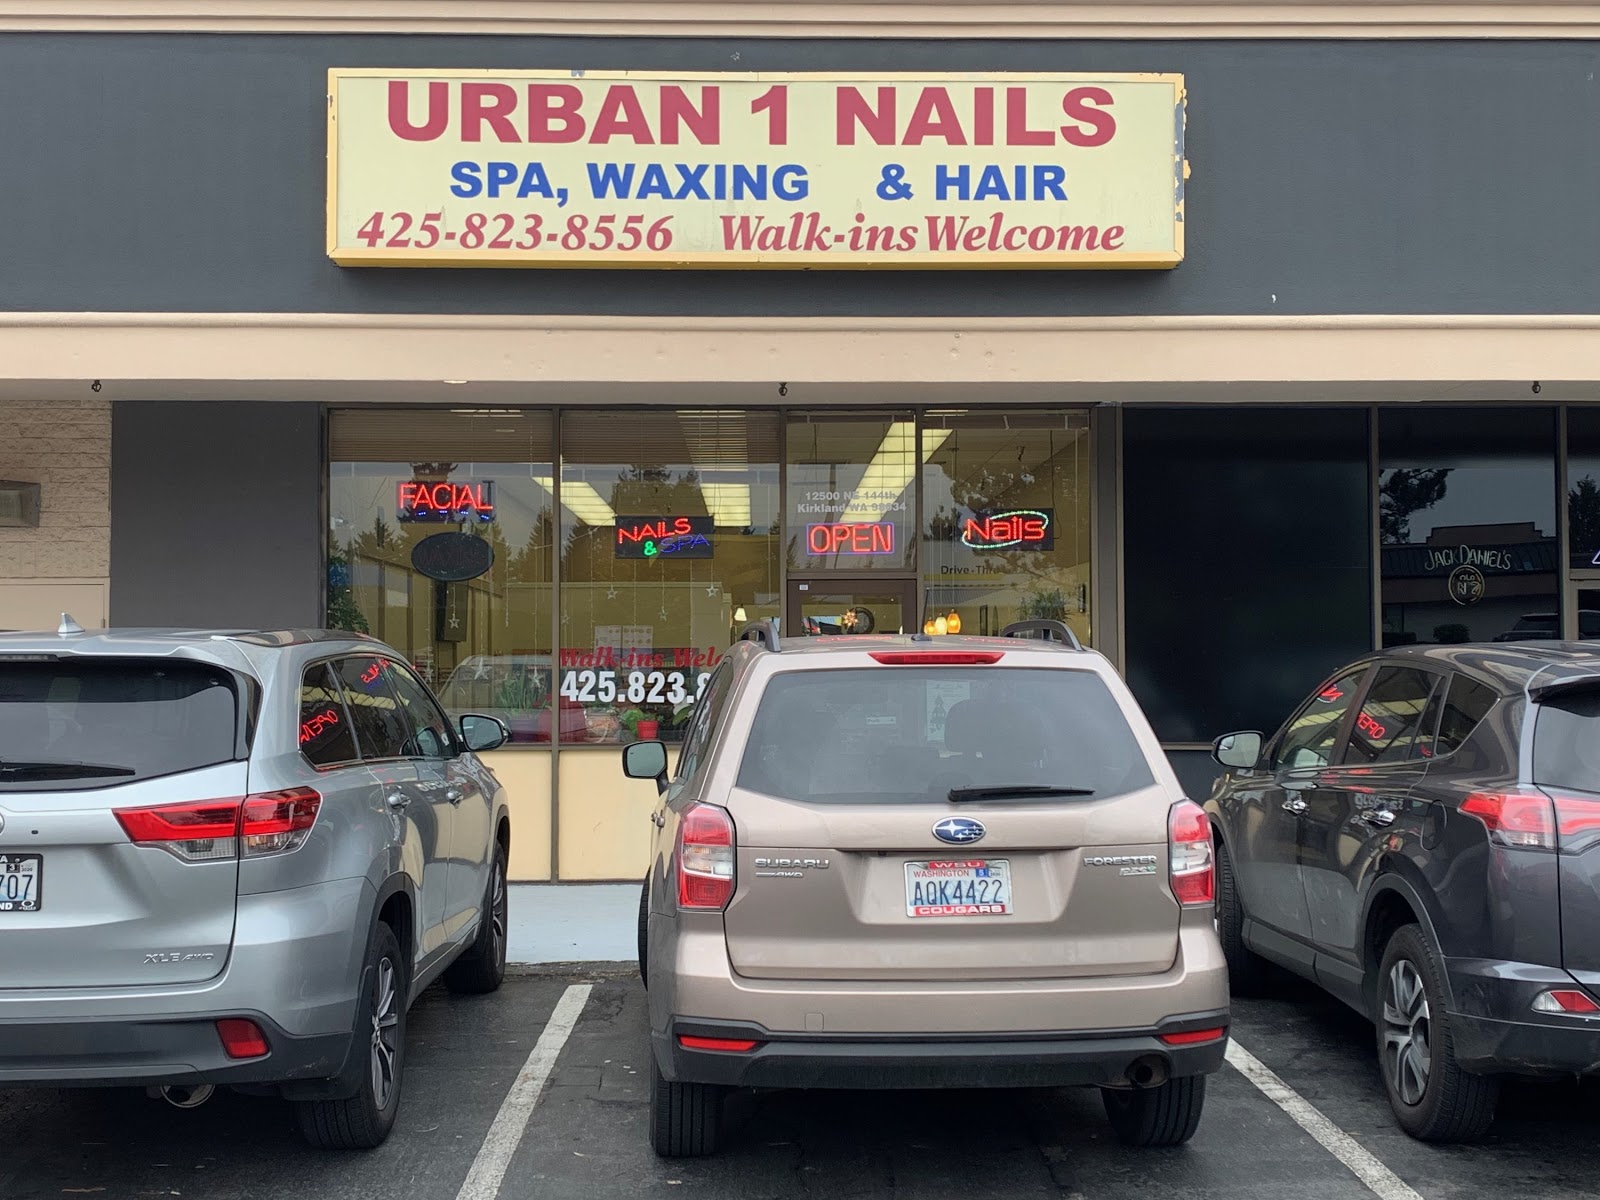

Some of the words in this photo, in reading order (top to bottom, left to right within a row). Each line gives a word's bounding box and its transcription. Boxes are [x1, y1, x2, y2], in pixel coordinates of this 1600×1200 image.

[387, 80, 721, 145] URBAN
[751, 85, 788, 145] 1
[836, 86, 1117, 147] NAILS
[450, 161, 568, 207] SPA,
[586, 163, 809, 201] WAXING
[876, 163, 915, 201] &
[935, 164, 1068, 201] HAIR
[357, 211, 674, 252] 425-823-8556
[720, 212, 918, 252] Walk-ins
[925, 212, 1125, 252] Welcome
[399, 484, 494, 510] FACIAL
[805, 491, 840, 501] 12500
[843, 490, 860, 501] NE
[797, 503, 845, 513] Kirkland
[849, 503, 868, 512] WA
[618, 517, 692, 545] NAILS
[810, 524, 892, 553] OPEN
[965, 516, 1045, 541] Nails
[643, 540, 658, 556] &
[660, 532, 711, 553] SPA
[1424, 549, 1459, 571] JACK
[1459, 544, 1512, 570] DANIEL'S
[559, 646, 665, 668] Walk-ins
[755, 858, 829, 869] SUBARU
[1084, 855, 1157, 867] FORESTER
[914, 869, 970, 878] WASHINGTON
[914, 879, 1004, 905] AQK4422
[918, 905, 1003, 915] COUGARS
[143, 952, 181, 964] XLE
